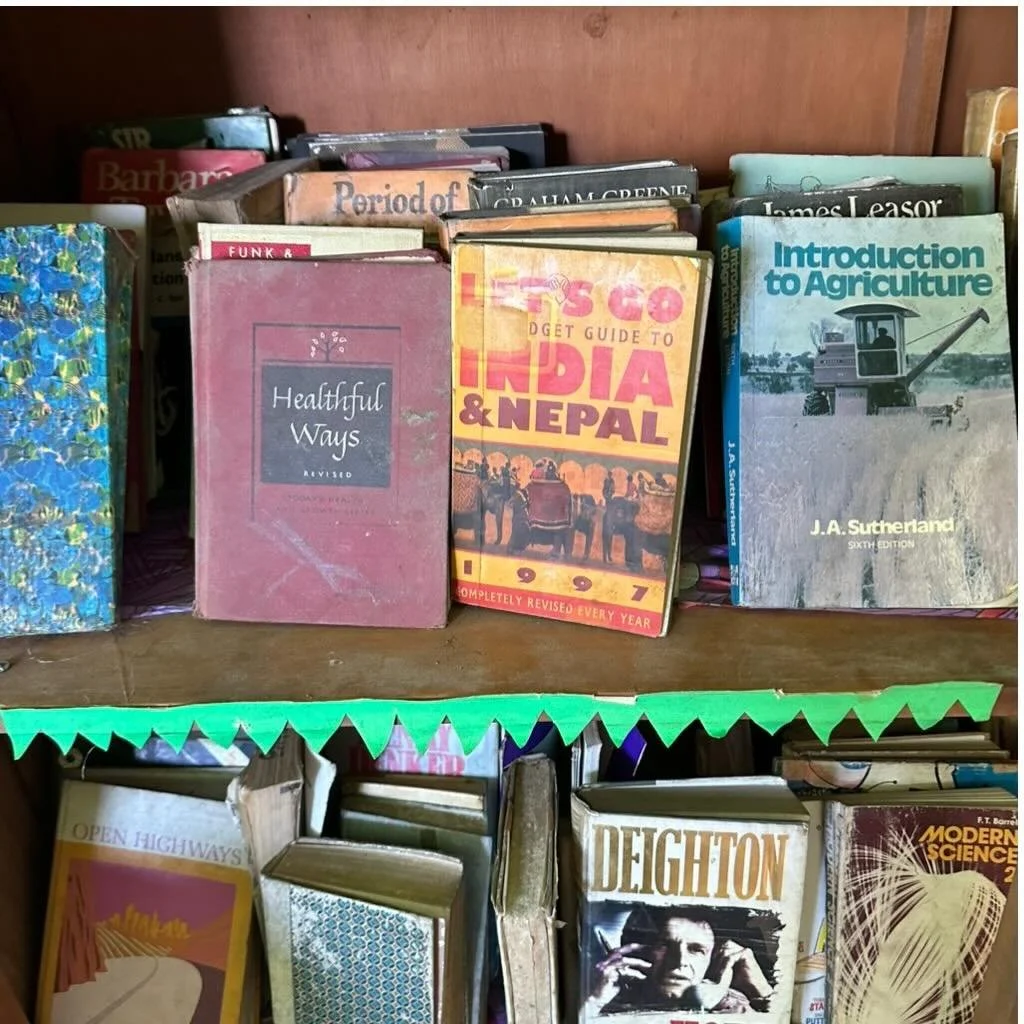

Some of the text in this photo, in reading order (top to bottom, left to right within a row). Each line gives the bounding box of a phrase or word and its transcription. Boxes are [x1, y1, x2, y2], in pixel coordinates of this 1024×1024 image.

[333, 181, 461, 216] Period of
[848, 195, 943, 217] Leasor
[228, 246, 293, 259] FUNK &
[774, 241, 985, 269] Introduction
[764, 271, 993, 301] to Agriculture
[608, 280, 683, 324] GO
[529, 321, 674, 347] DGET GUIDE TO
[459, 341, 674, 408] INDIA
[272, 381, 387, 421] Healthful
[290, 421, 361, 462] Ways
[303, 470, 354, 479] REVISED
[728, 469, 737, 547] Sutherland
[848, 517, 955, 536] Sutherland
[848, 539, 915, 550] SIXTH EDITION
[527, 598, 574, 616] REVISED
[576, 605, 616, 621] EVERY
[620, 613, 650, 629] YEAR
[72, 822, 242, 866] OPEN HIGHWAYS
[918, 825, 1018, 846] MODERN
[590, 823, 789, 903] DEIGHTON
[927, 843, 1018, 865] SCIENCE
[1003, 866, 1016, 884] 2
